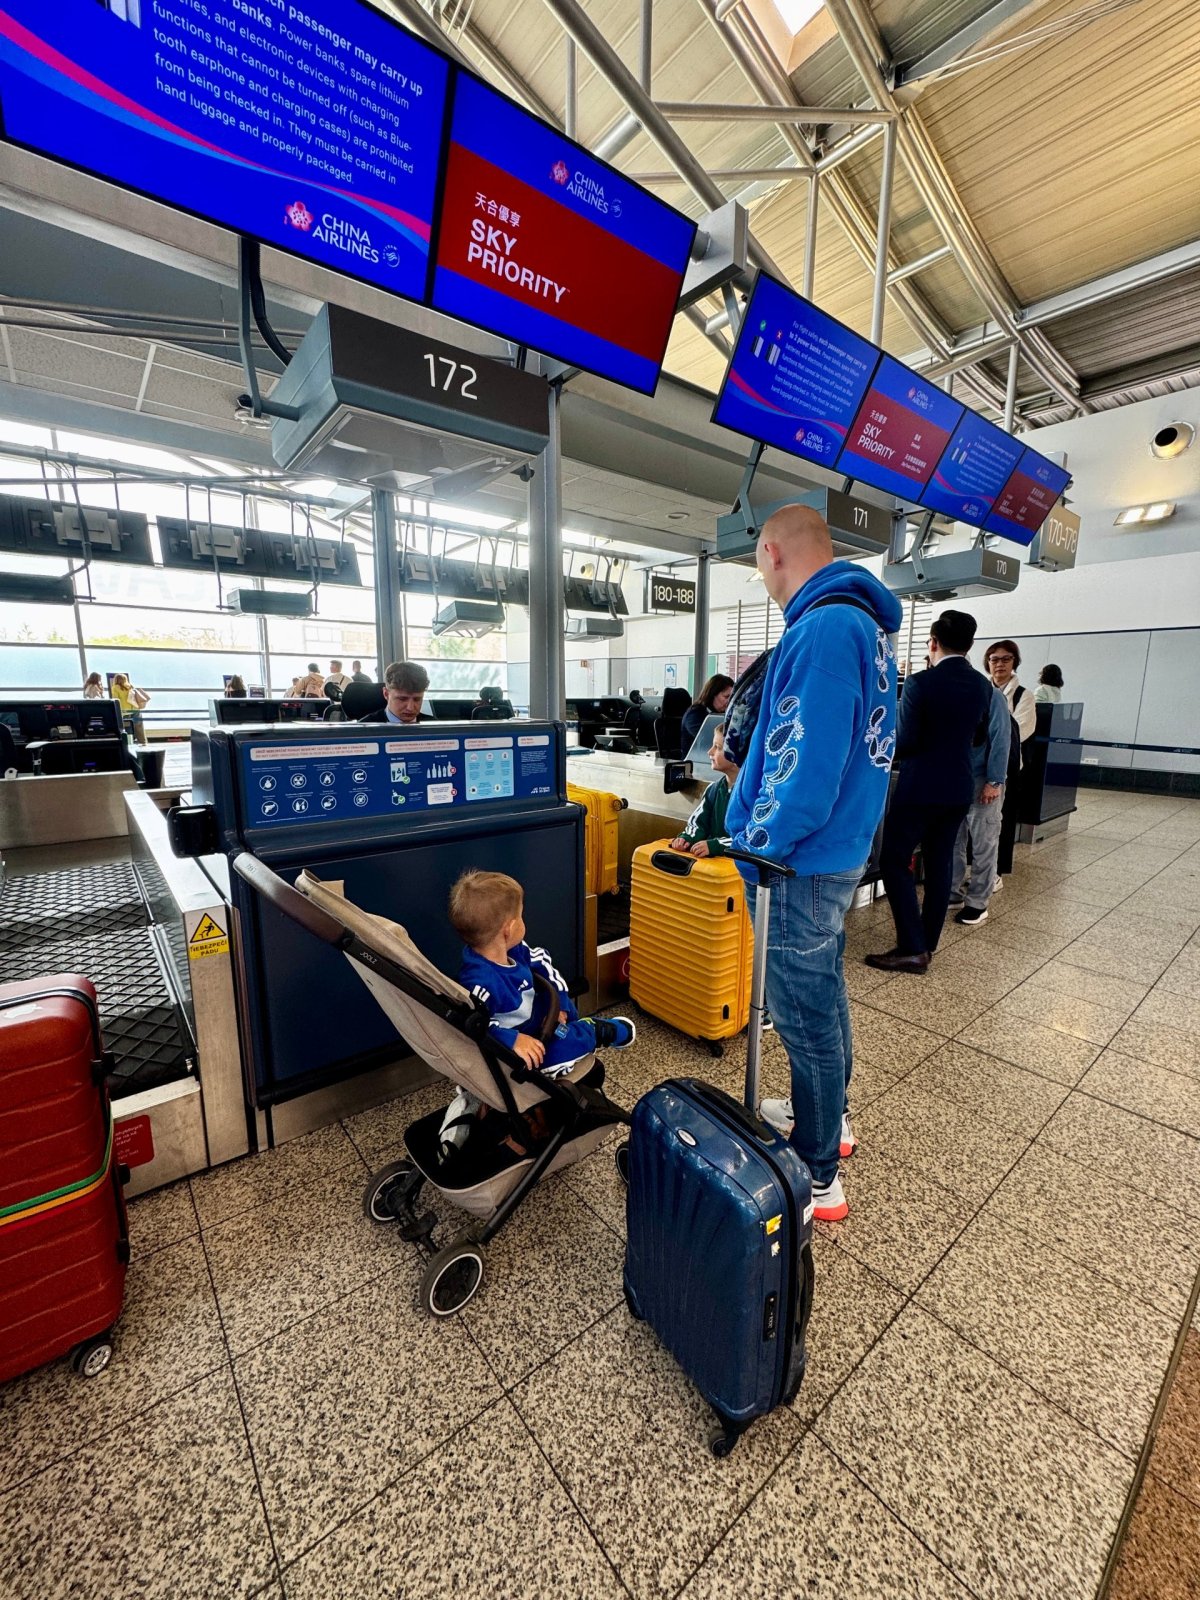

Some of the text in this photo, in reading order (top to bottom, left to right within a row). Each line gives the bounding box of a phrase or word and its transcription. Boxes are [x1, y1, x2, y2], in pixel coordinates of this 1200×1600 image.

[215, 13, 399, 126] and electronic devices with charging
[280, 23, 312, 50] Power
[316, 45, 347, 74] banks,
[350, 69, 376, 89] spare
[380, 83, 409, 109] lithium
[289, 6, 351, 50] passenger
[355, 47, 377, 69] may
[381, 63, 407, 87] carry
[410, 82, 422, 96] up
[153, 1, 211, 42] functions
[215, 36, 237, 57] that
[242, 53, 278, 80] cannot
[283, 73, 294, 88] be
[298, 83, 330, 107] turned
[332, 103, 347, 116] off
[350, 110, 375, 132] (such
[378, 128, 388, 139] as
[390, 133, 412, 151] Blue-
[154, 28, 413, 173] tooth earphone and charging cases) are prohibited
[155, 53, 396, 184] from being checked in. They must be carried in
[157, 77, 354, 184] hand luggage and properly packaged.
[566, 180, 608, 214] AIRLINES
[574, 171, 604, 199] CHINA
[475, 191, 522, 228] 天合優享
[312, 225, 380, 263] AIRLINES
[322, 213, 371, 246] CHINA
[470, 218, 518, 256] SKY
[467, 242, 566, 303] PRIORITY
[423, 353, 478, 400] 172
[801, 438, 824, 452] AIRLINES
[807, 432, 823, 444] CHINA
[857, 435, 895, 460] PRIORITY
[863, 423, 882, 440] SKY
[853, 507, 868, 528] 171
[1048, 517, 1078, 554] 170-178
[996, 560, 1006, 575] 170
[653, 585, 694, 604] 180-188
